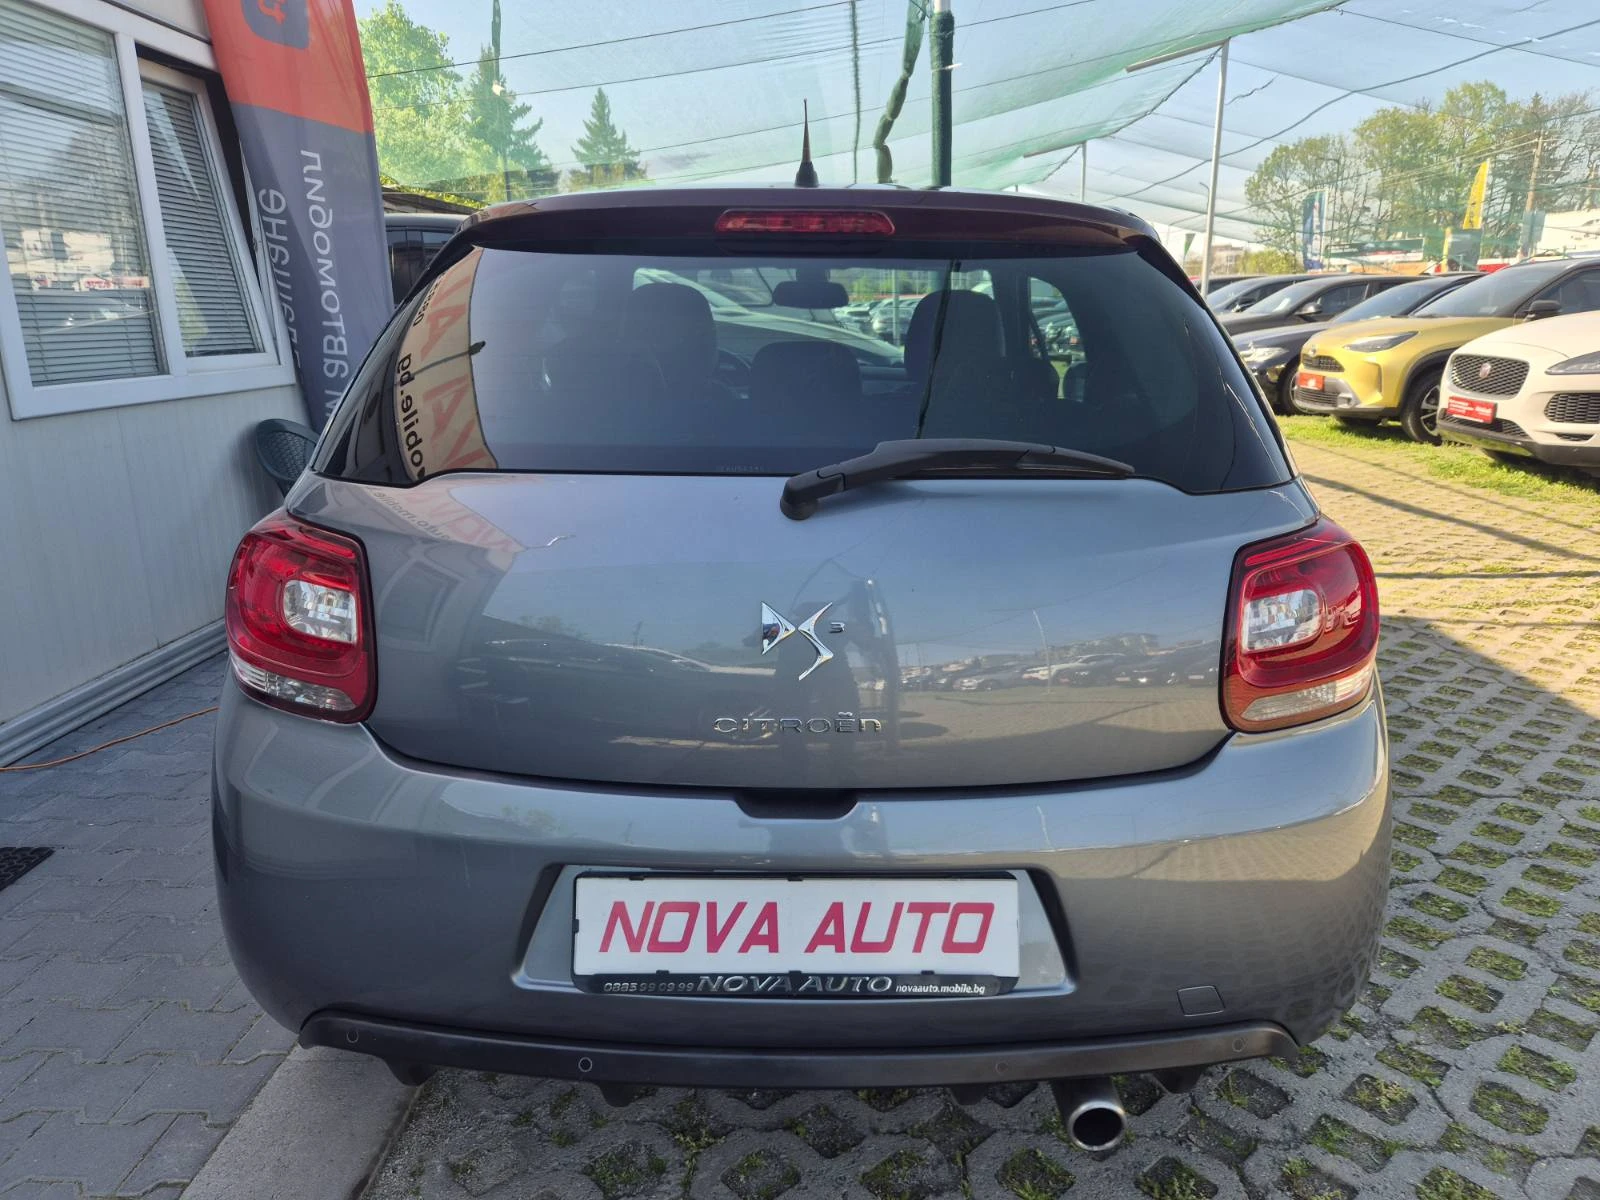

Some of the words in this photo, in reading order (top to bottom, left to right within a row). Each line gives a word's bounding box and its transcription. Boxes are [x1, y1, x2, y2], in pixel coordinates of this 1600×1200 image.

[599, 900, 779, 954] NOVA
[803, 901, 995, 954] AUTO
[697, 975, 793, 992] NOVA
[799, 976, 893, 993] AUTO
[895, 983, 986, 995] novaauto.mobile.bg
